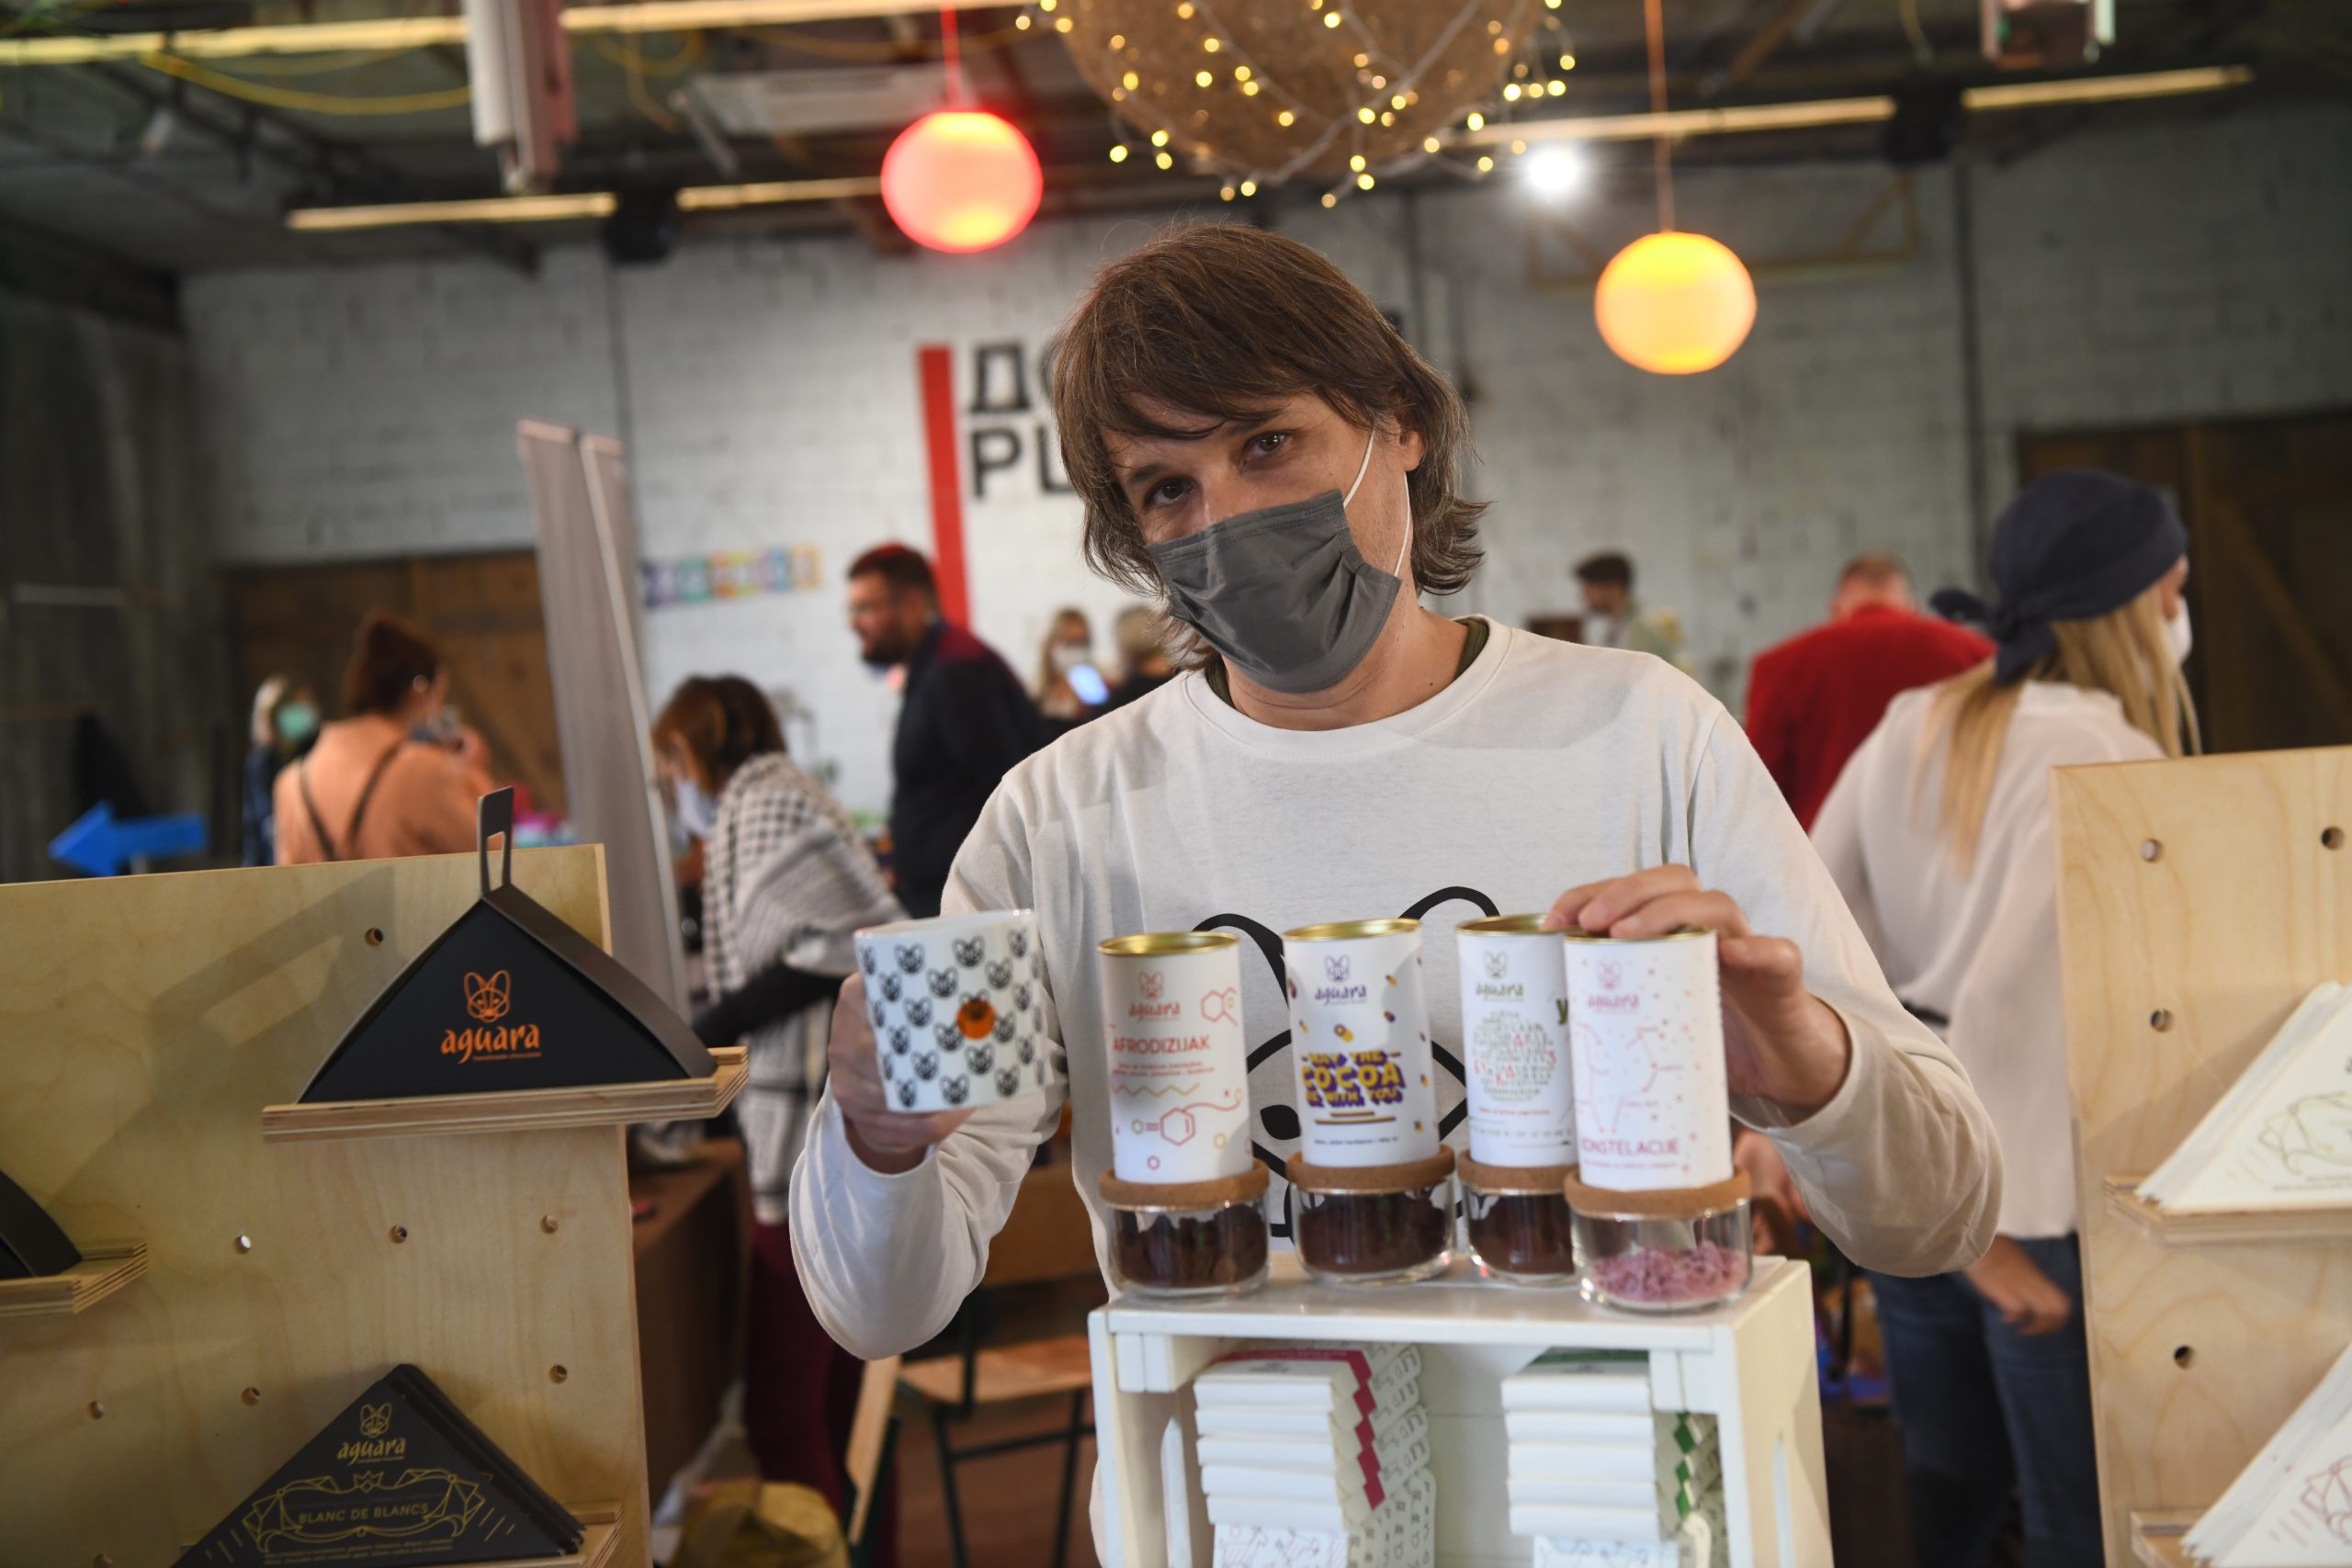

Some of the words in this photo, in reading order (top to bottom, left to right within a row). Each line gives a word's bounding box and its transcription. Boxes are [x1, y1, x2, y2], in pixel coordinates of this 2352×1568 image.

[440, 1023, 540, 1066] aguara
[1301, 1062, 1406, 1091] COCOA
[336, 1438, 406, 1467] aguara
[298, 1510, 346, 1525] BLANC
[350, 1508, 369, 1521] DE
[372, 1503, 429, 1519] BLANCS
